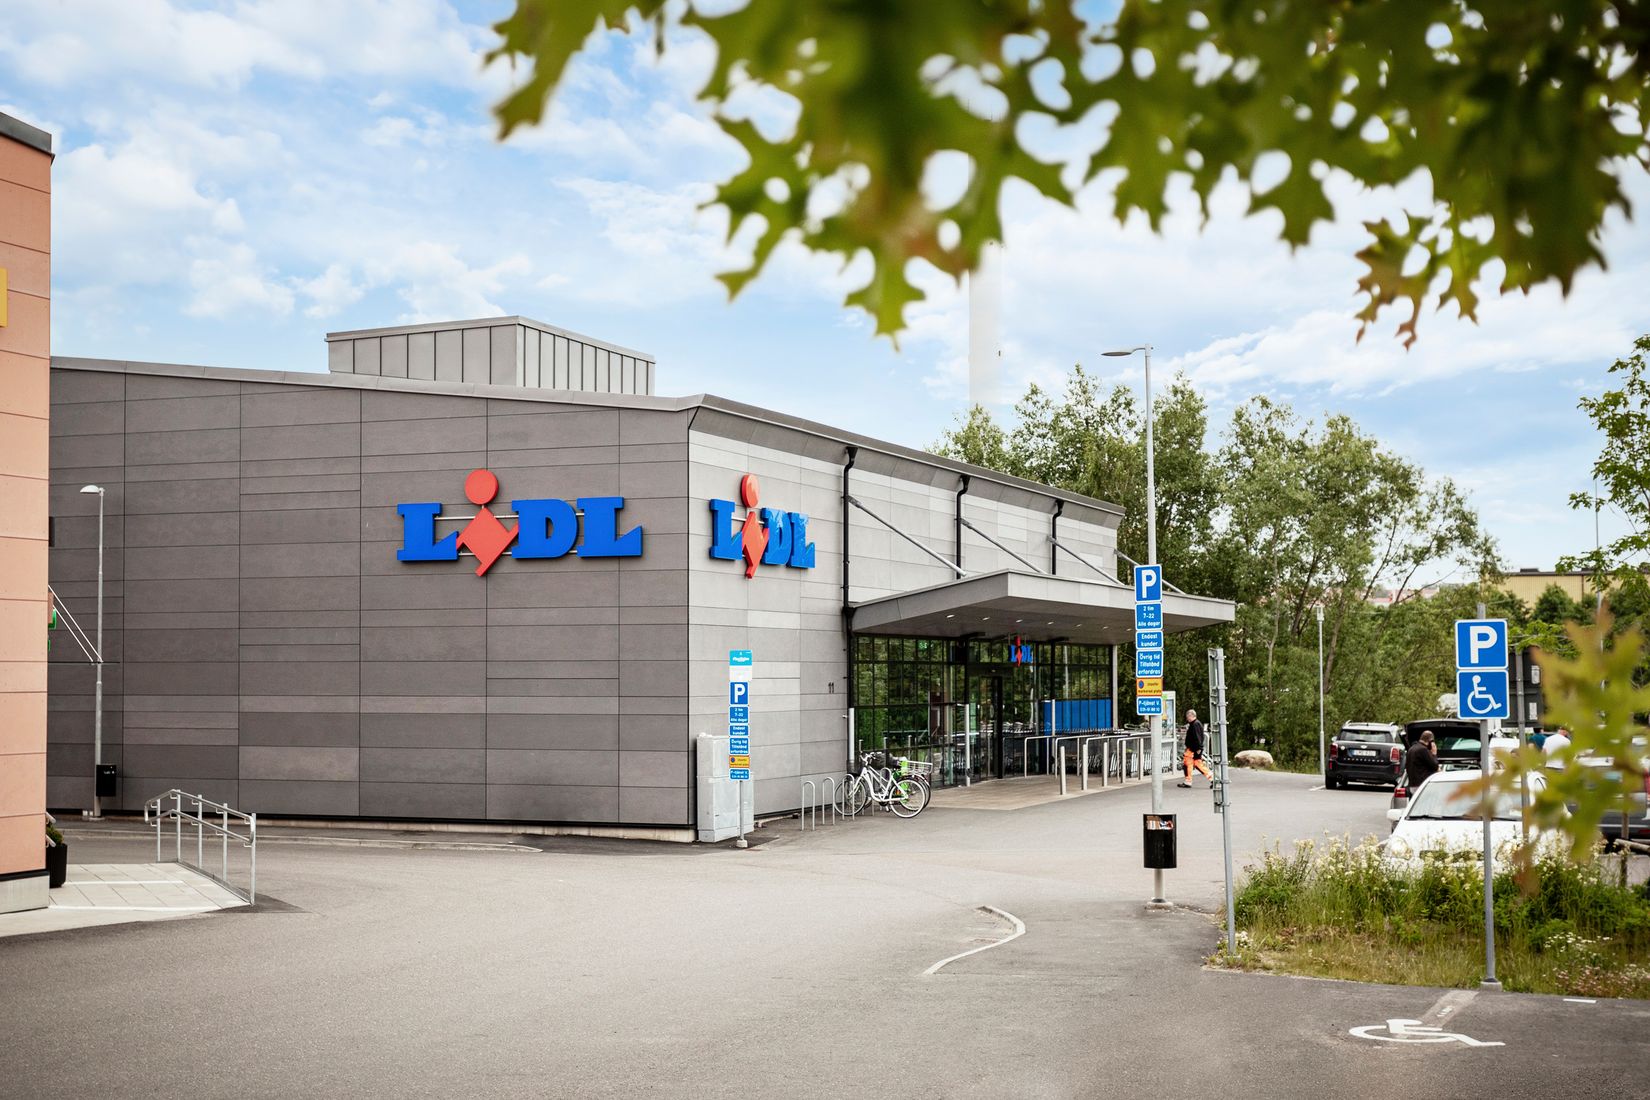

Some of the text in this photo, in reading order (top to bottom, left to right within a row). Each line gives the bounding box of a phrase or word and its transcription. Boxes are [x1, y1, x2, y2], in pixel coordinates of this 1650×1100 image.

[1141, 569, 1157, 599] P
[1139, 653, 1153, 661] Övrig
[1469, 625, 1498, 664] P
[734, 683, 746, 703] P
